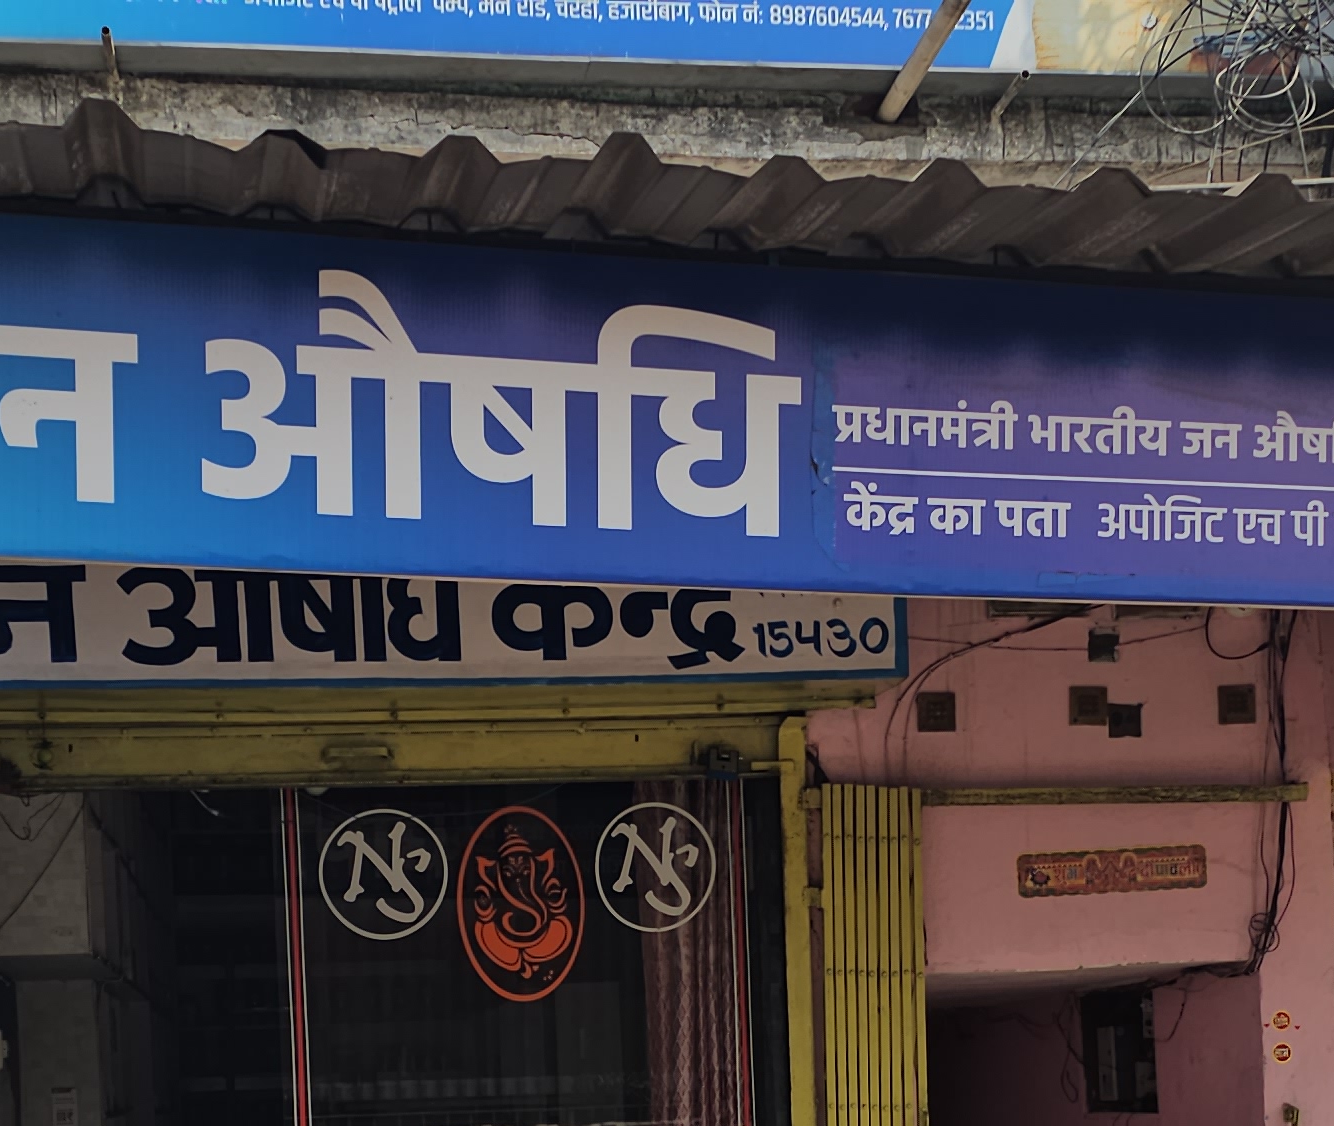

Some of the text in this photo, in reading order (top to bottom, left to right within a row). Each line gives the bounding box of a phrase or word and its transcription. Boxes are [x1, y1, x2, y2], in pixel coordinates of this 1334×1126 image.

[769, 4, 890, 31] 8987604544,
[892, 8, 994, 31] 76772351
[200, 268, 802, 538] औषधि
[831, 400, 1018, 450] प्रधानमंत्री
[1028, 405, 1171, 456] भारतीय
[1179, 421, 1242, 459] जन
[843, 481, 919, 535] केंद्र
[927, 498, 986, 536] का
[995, 499, 1071, 538] पता
[1097, 493, 1227, 543] अपोजिट
[1232, 508, 1285, 545] एच
[1290, 500, 1329, 547] पी
[752, 617, 889, 658] 15430
